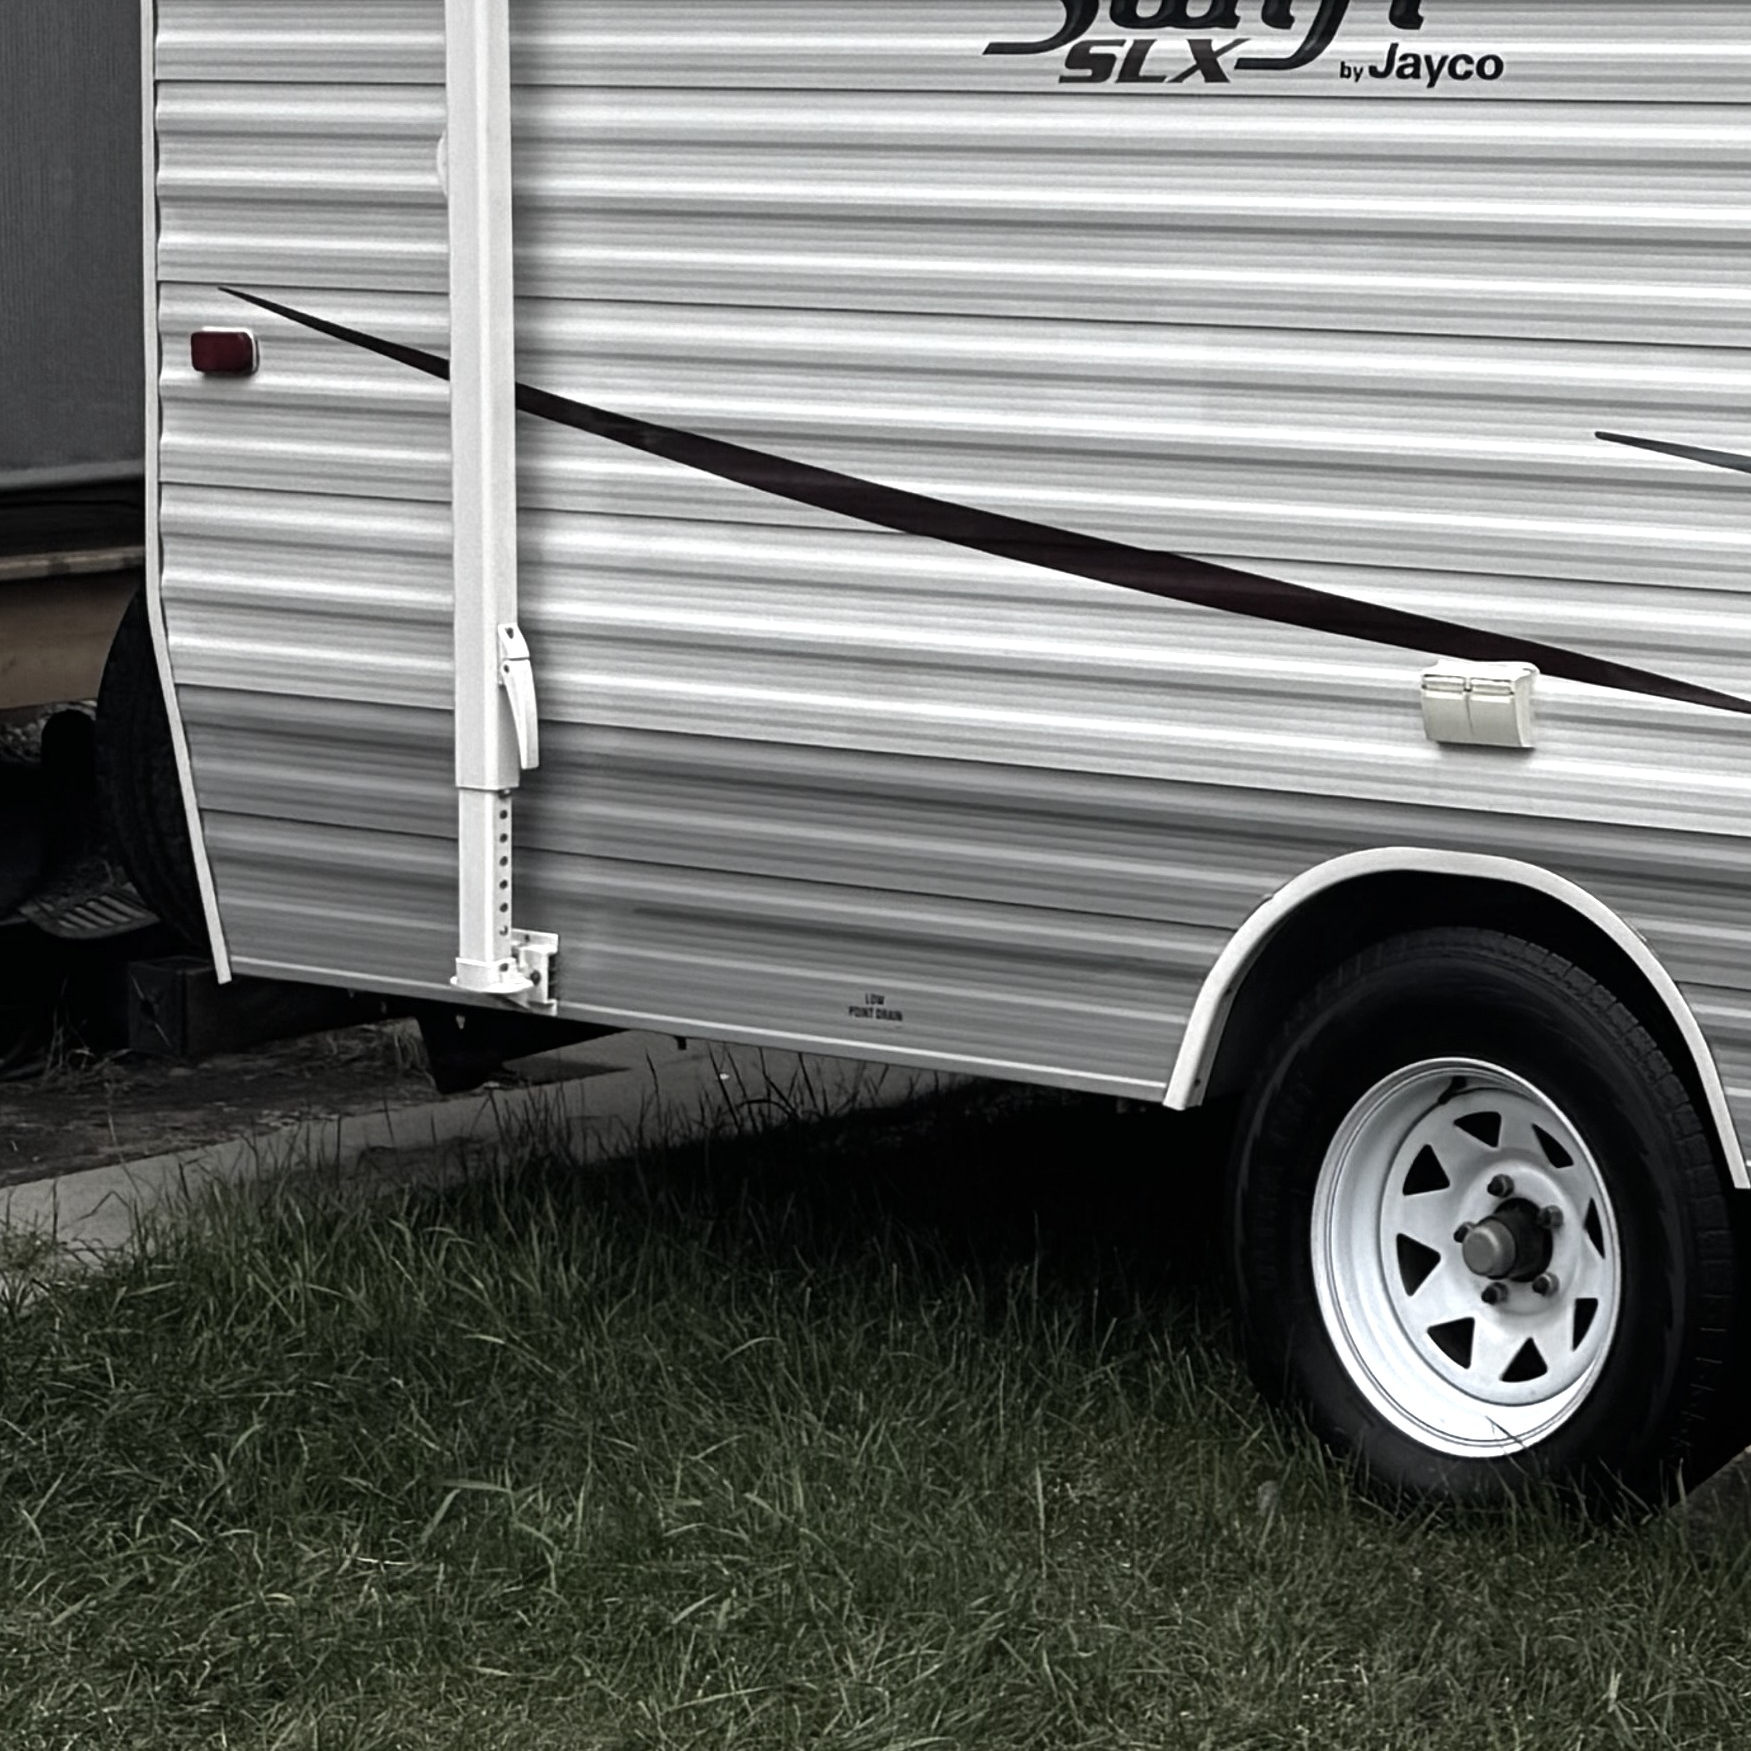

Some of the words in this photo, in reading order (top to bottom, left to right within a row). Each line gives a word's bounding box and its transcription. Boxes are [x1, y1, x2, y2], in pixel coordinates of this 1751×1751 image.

[1058, 37, 1252, 84] SLX
[1338, 60, 1364, 83] by
[1367, 42, 1505, 89] Jayco
